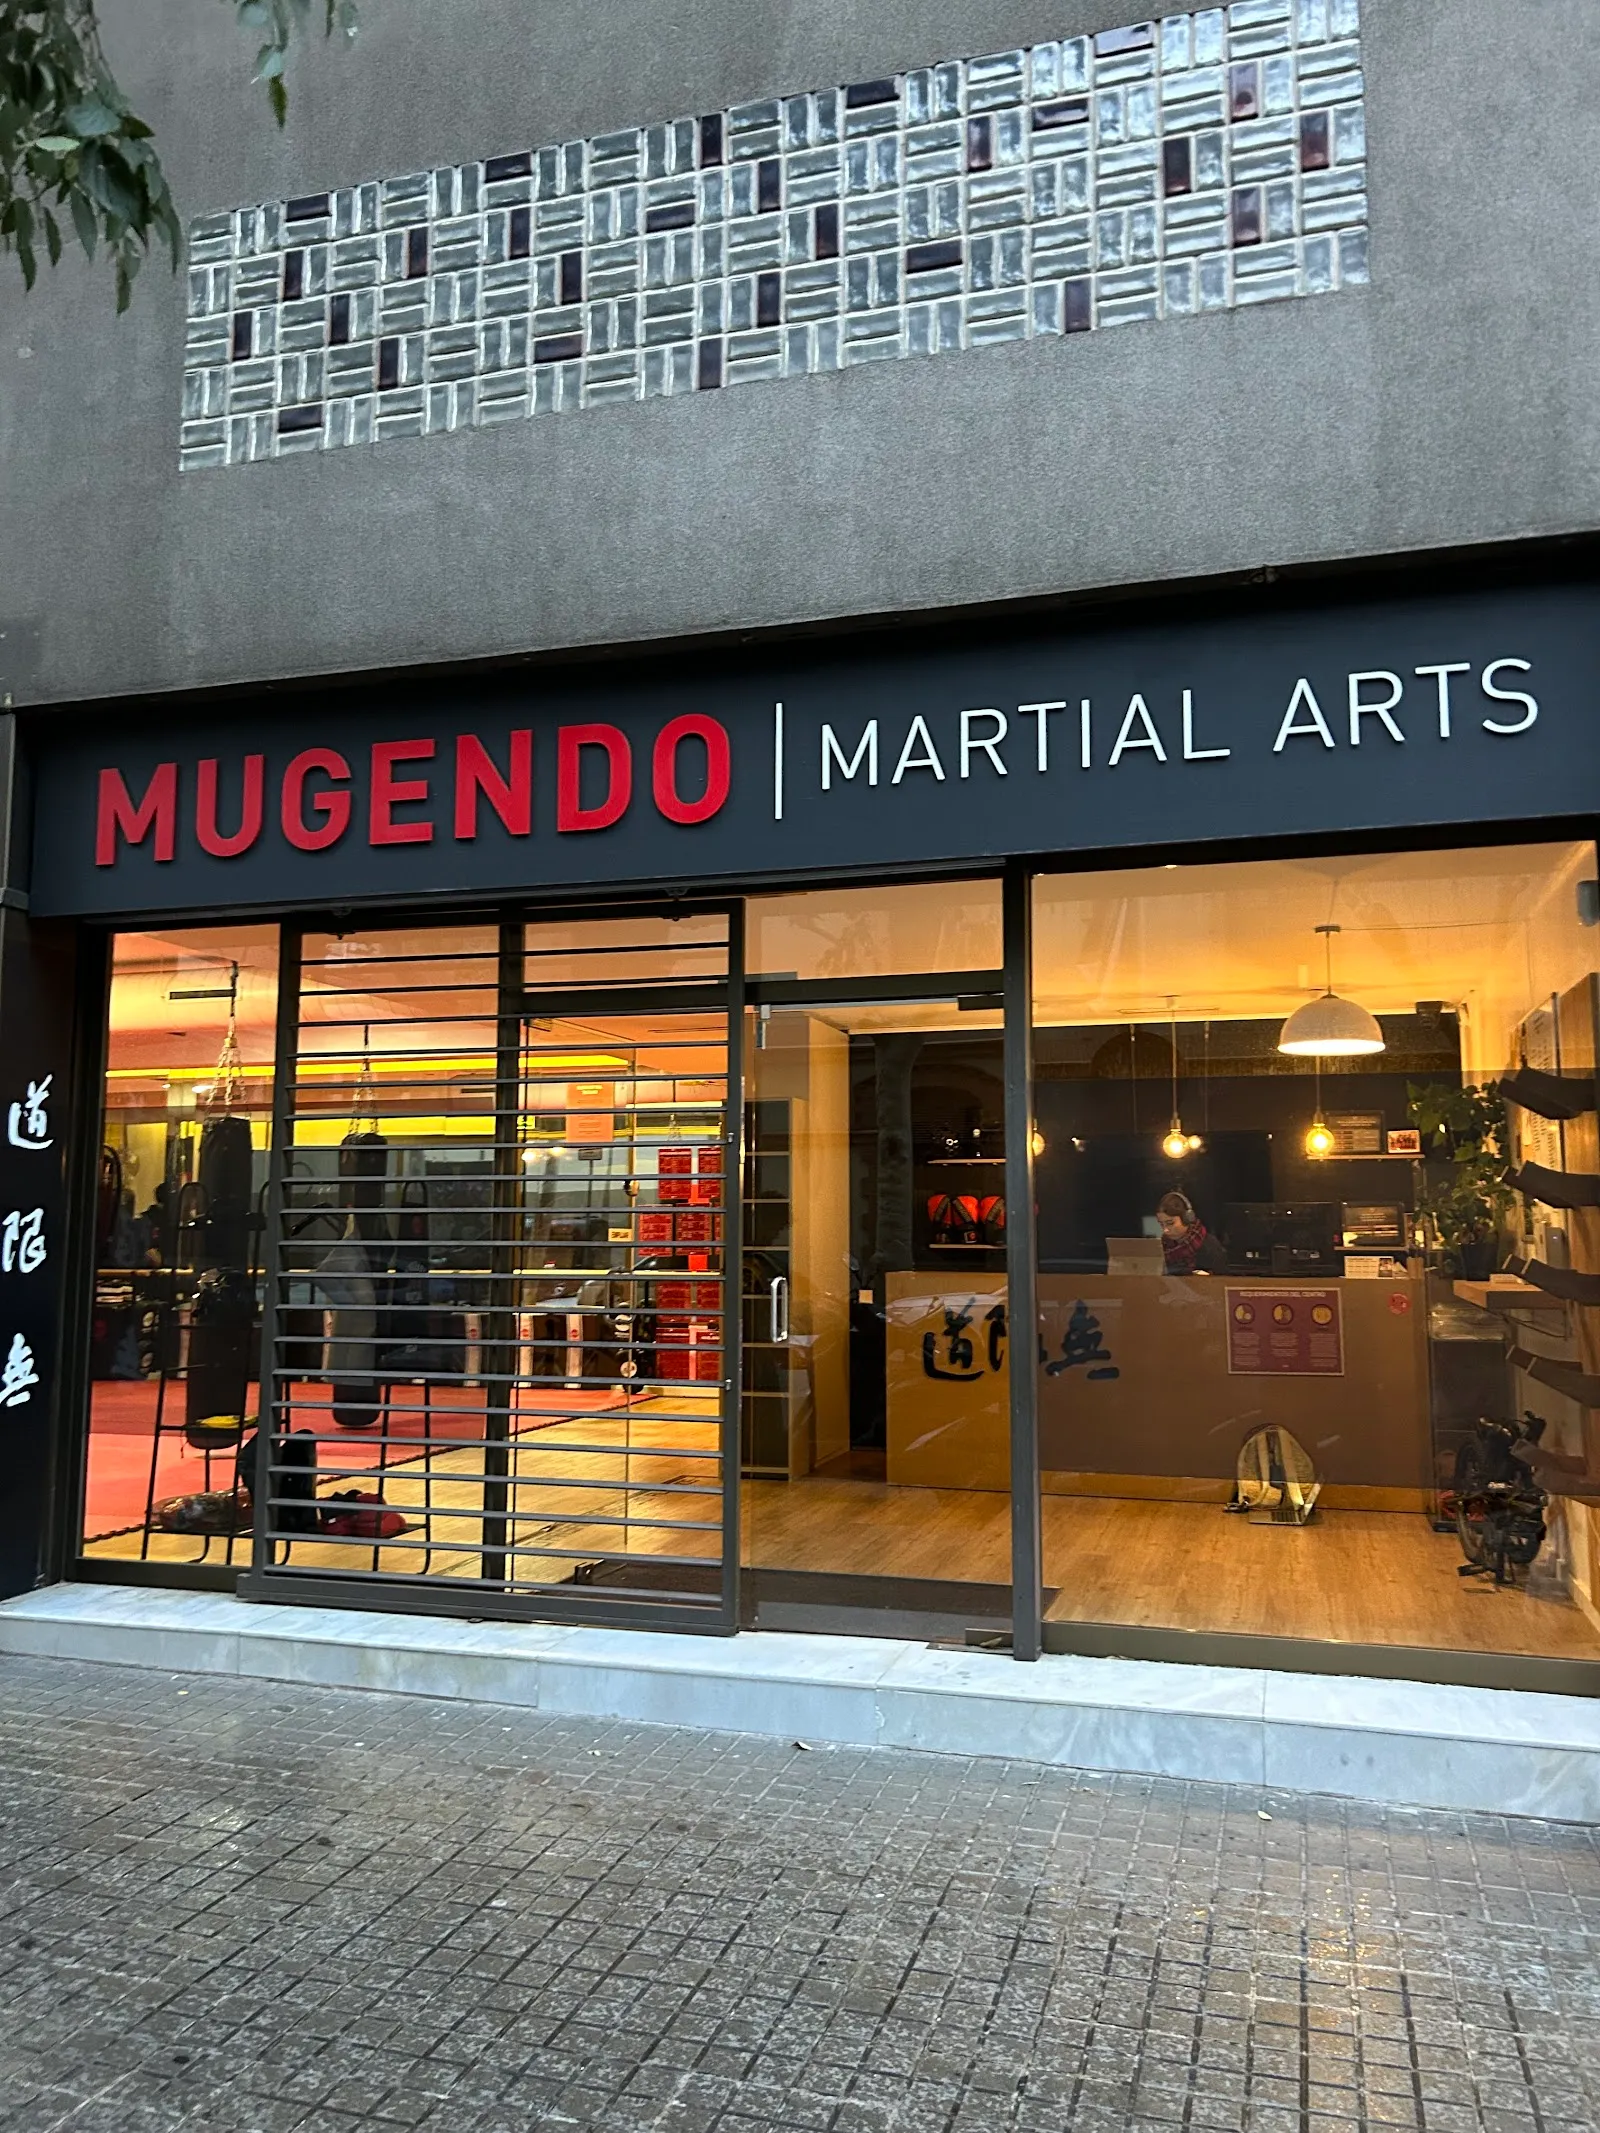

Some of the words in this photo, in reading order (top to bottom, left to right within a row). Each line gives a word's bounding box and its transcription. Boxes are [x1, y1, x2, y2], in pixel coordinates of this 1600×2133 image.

[95, 713, 731, 866] MUGENDO
[821, 689, 1231, 790] MARTIAL
[1272, 657, 1539, 752] ARTS
